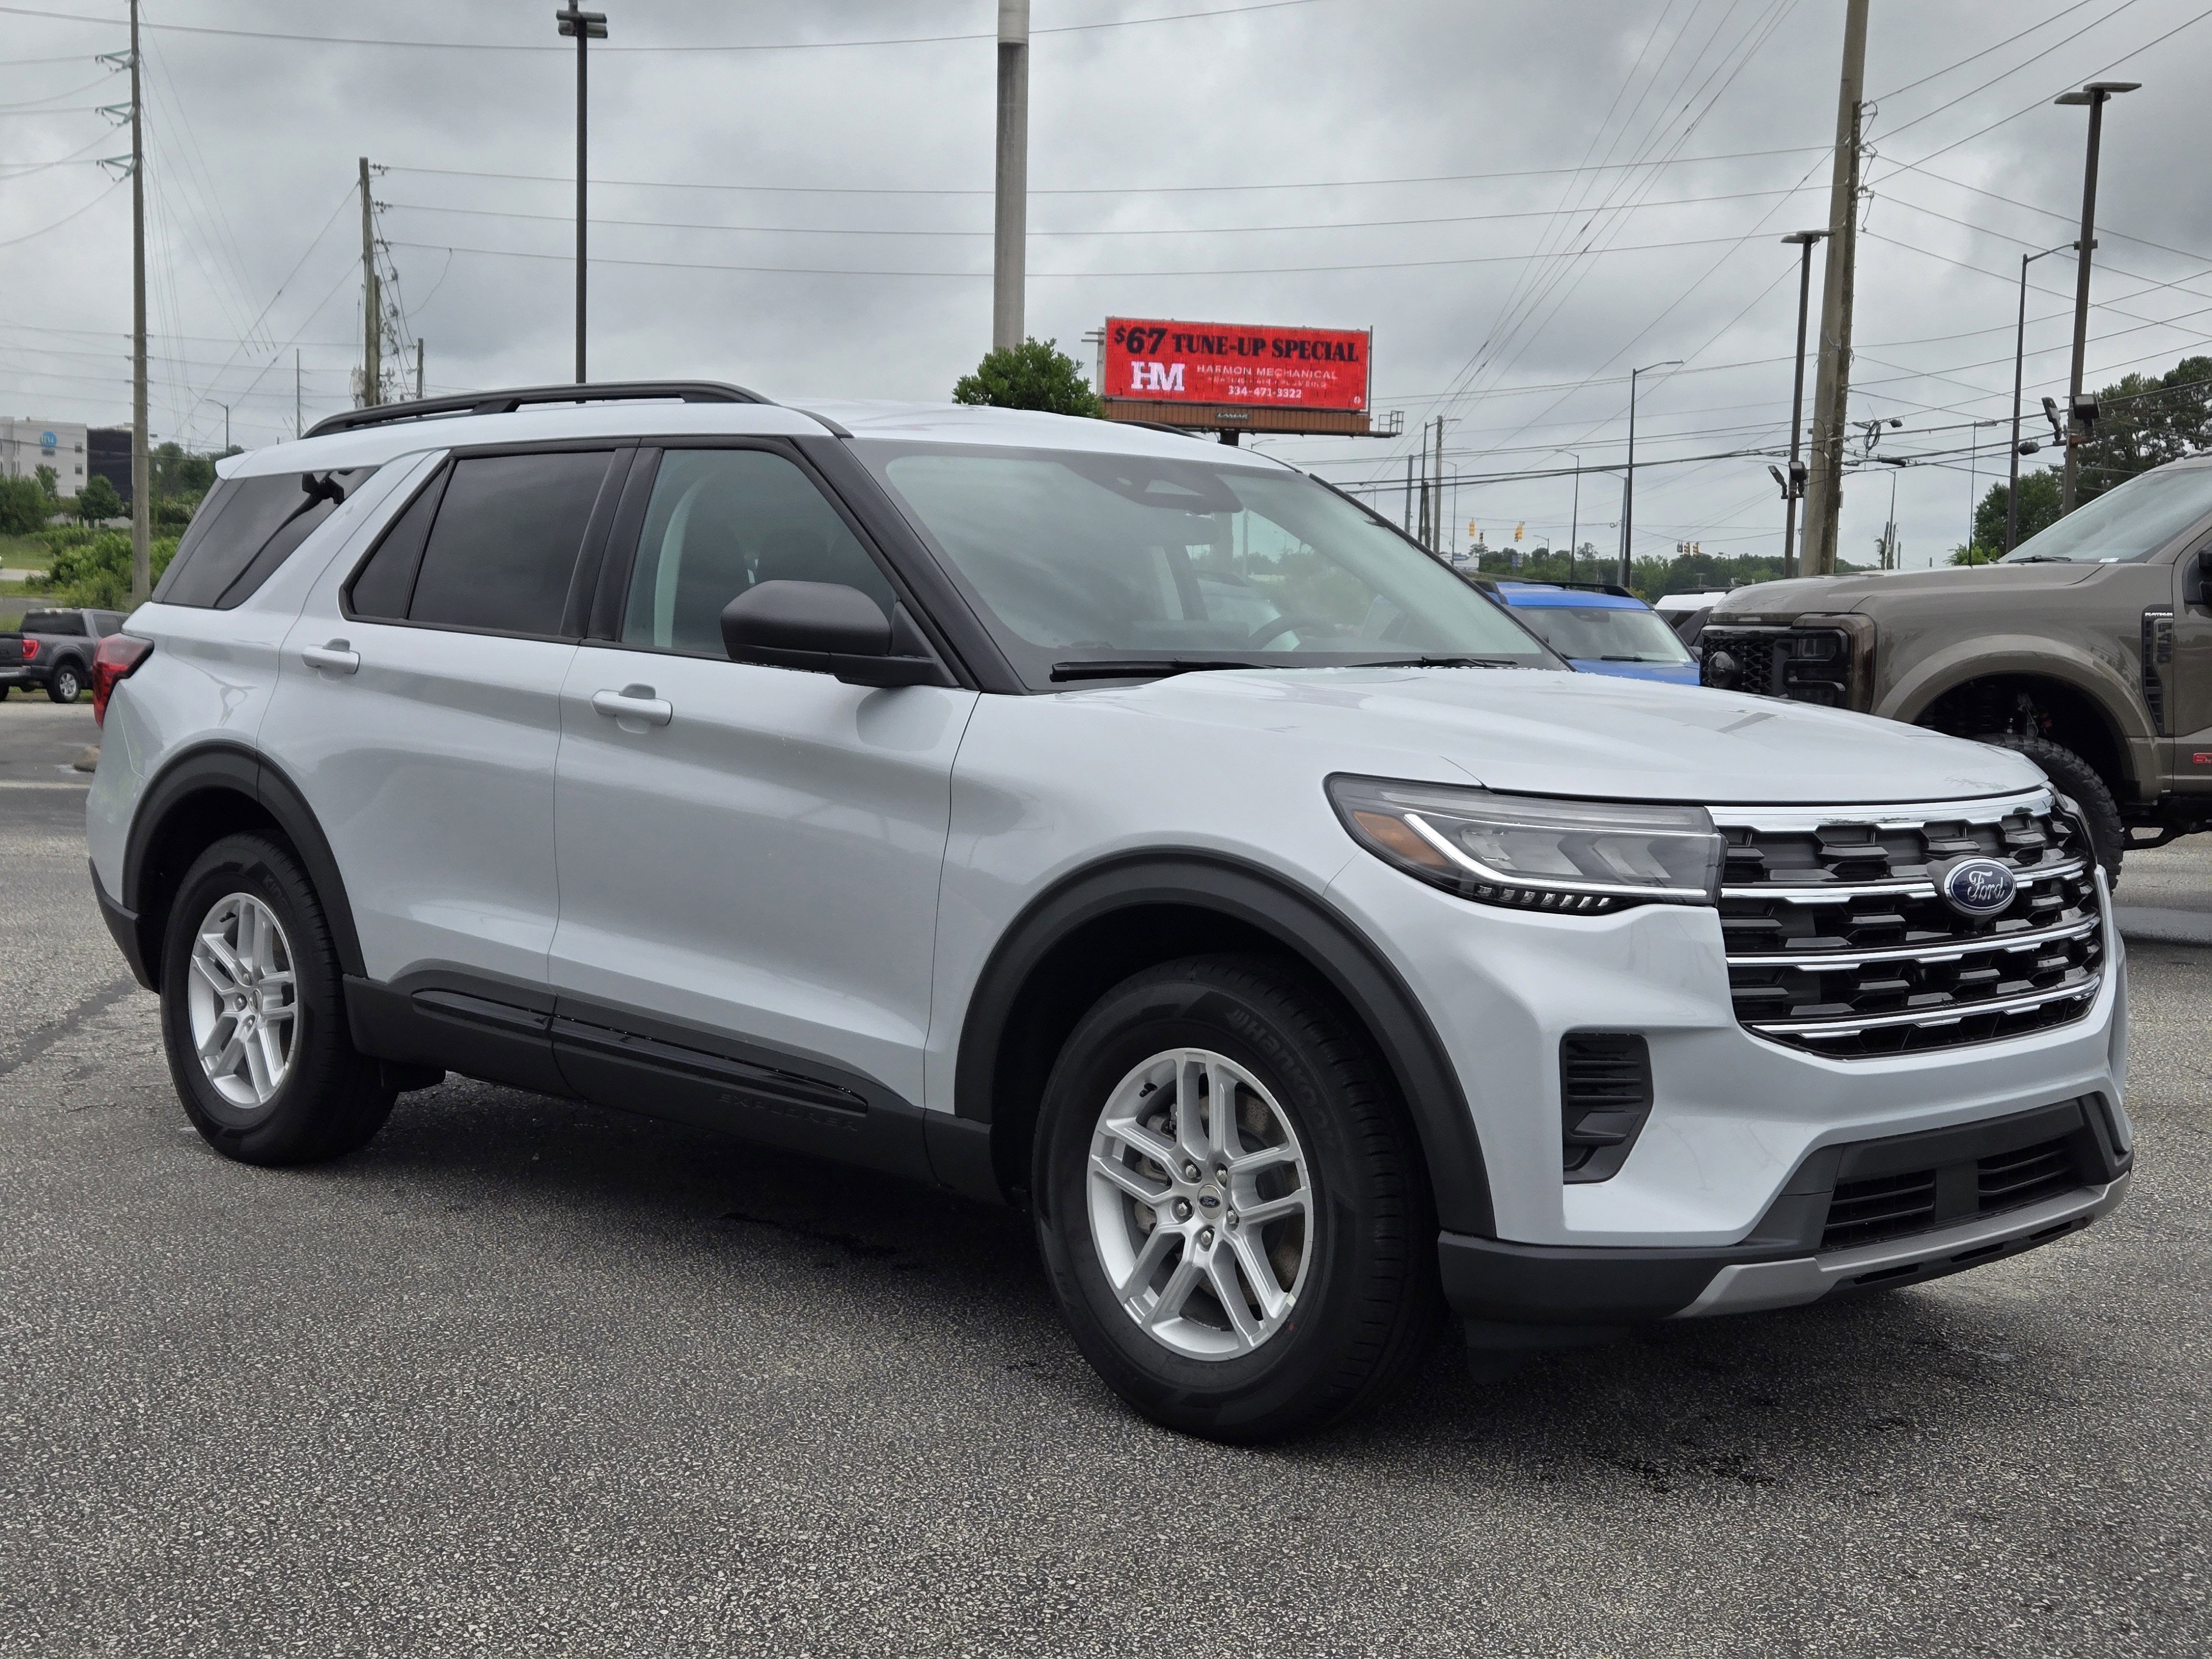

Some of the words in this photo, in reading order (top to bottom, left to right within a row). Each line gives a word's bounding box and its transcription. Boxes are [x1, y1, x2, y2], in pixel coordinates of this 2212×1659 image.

[1114, 325, 1168, 355] $67
[1171, 333, 1266, 357] TUNE-UP
[1272, 337, 1359, 362] SPECIAL
[1131, 361, 1186, 392] HM
[1197, 364, 1252, 375] HARMON
[1256, 367, 1338, 380] MECHANICAL
[1967, 870, 2006, 902] Ford
[1202, 1197, 1217, 1207] Ford
